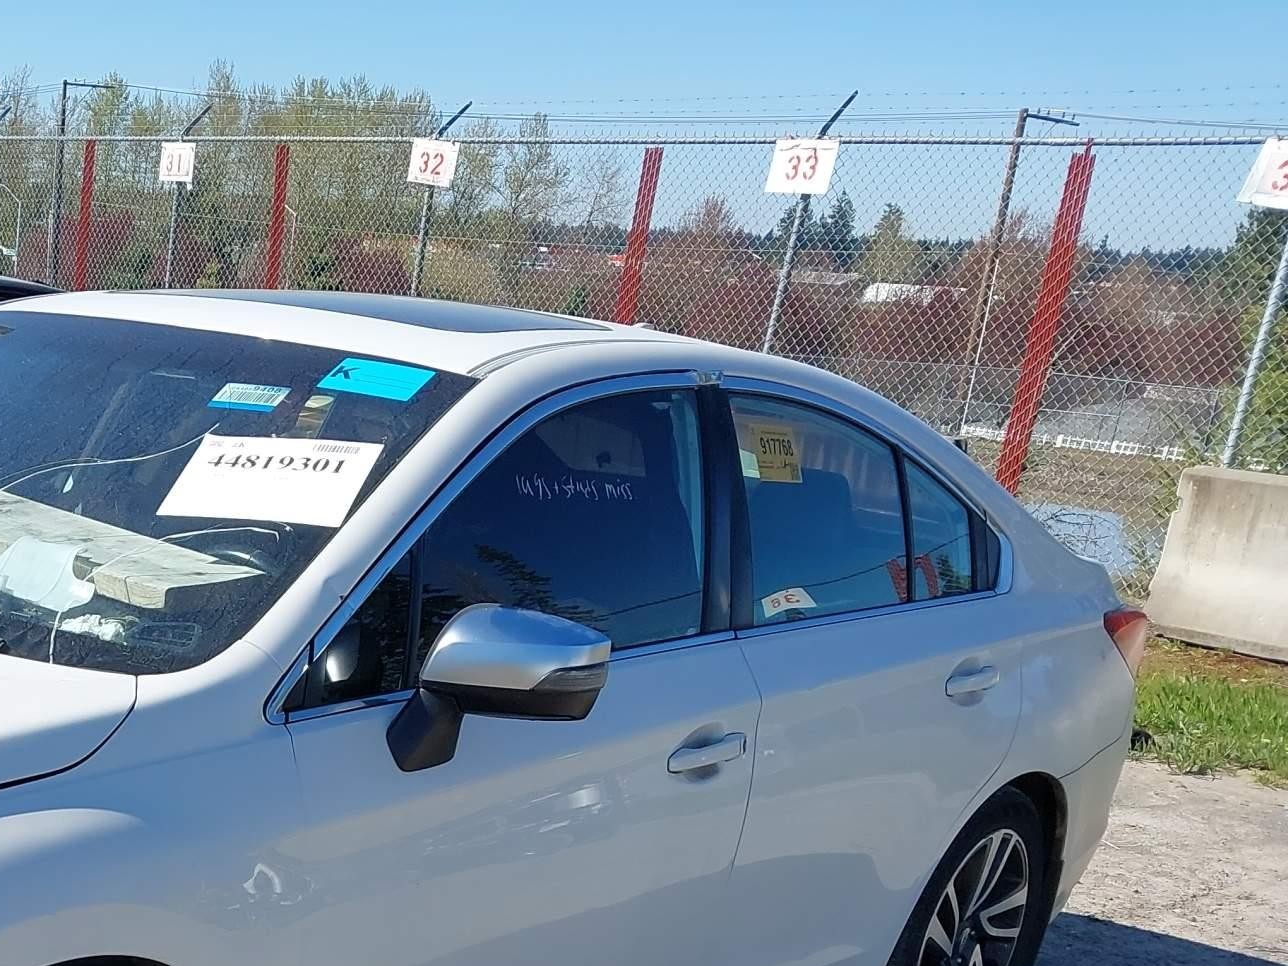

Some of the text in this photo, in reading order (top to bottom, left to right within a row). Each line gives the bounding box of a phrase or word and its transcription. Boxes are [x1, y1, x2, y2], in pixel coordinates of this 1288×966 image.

[166, 152, 182, 173] 31
[419, 152, 444, 175] 32
[785, 155, 818, 180] 33
[330, 366, 360, 379] K
[760, 437, 794, 456] 917768
[208, 453, 344, 473] 44819301
